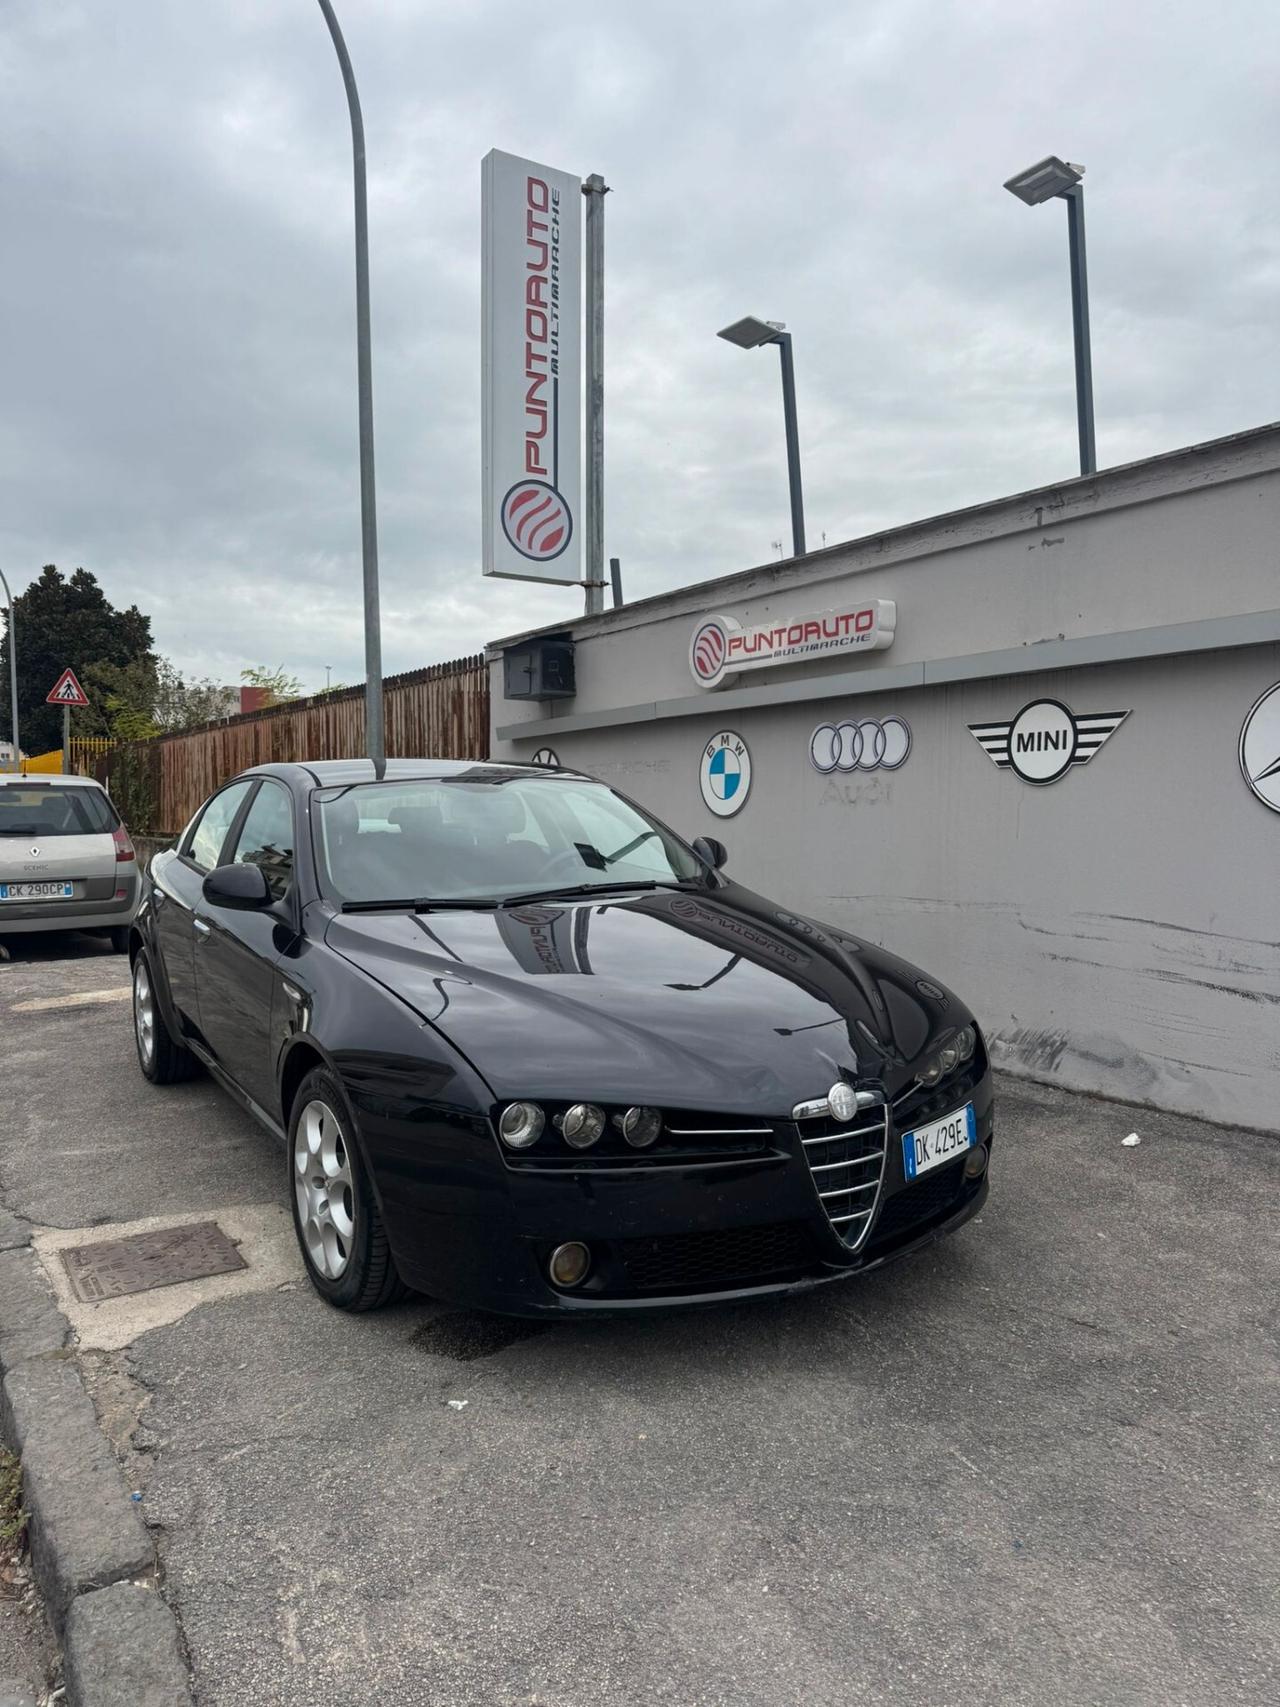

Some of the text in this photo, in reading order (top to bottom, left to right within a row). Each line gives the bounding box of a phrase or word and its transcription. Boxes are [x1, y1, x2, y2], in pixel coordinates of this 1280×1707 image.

[550, 186, 561, 375] MULTIMARCHE
[525, 176, 549, 475] PUNTOAUTO
[728, 609, 873, 657] PUNTOAUTO
[773, 633, 872, 658] MULTIMARCHE
[706, 734, 745, 759] BMW
[1016, 729, 1068, 753] MINI
[9, 883, 63, 897] CK 290CP
[915, 1134, 930, 1166] DK
[935, 1118, 968, 1155] 429E
